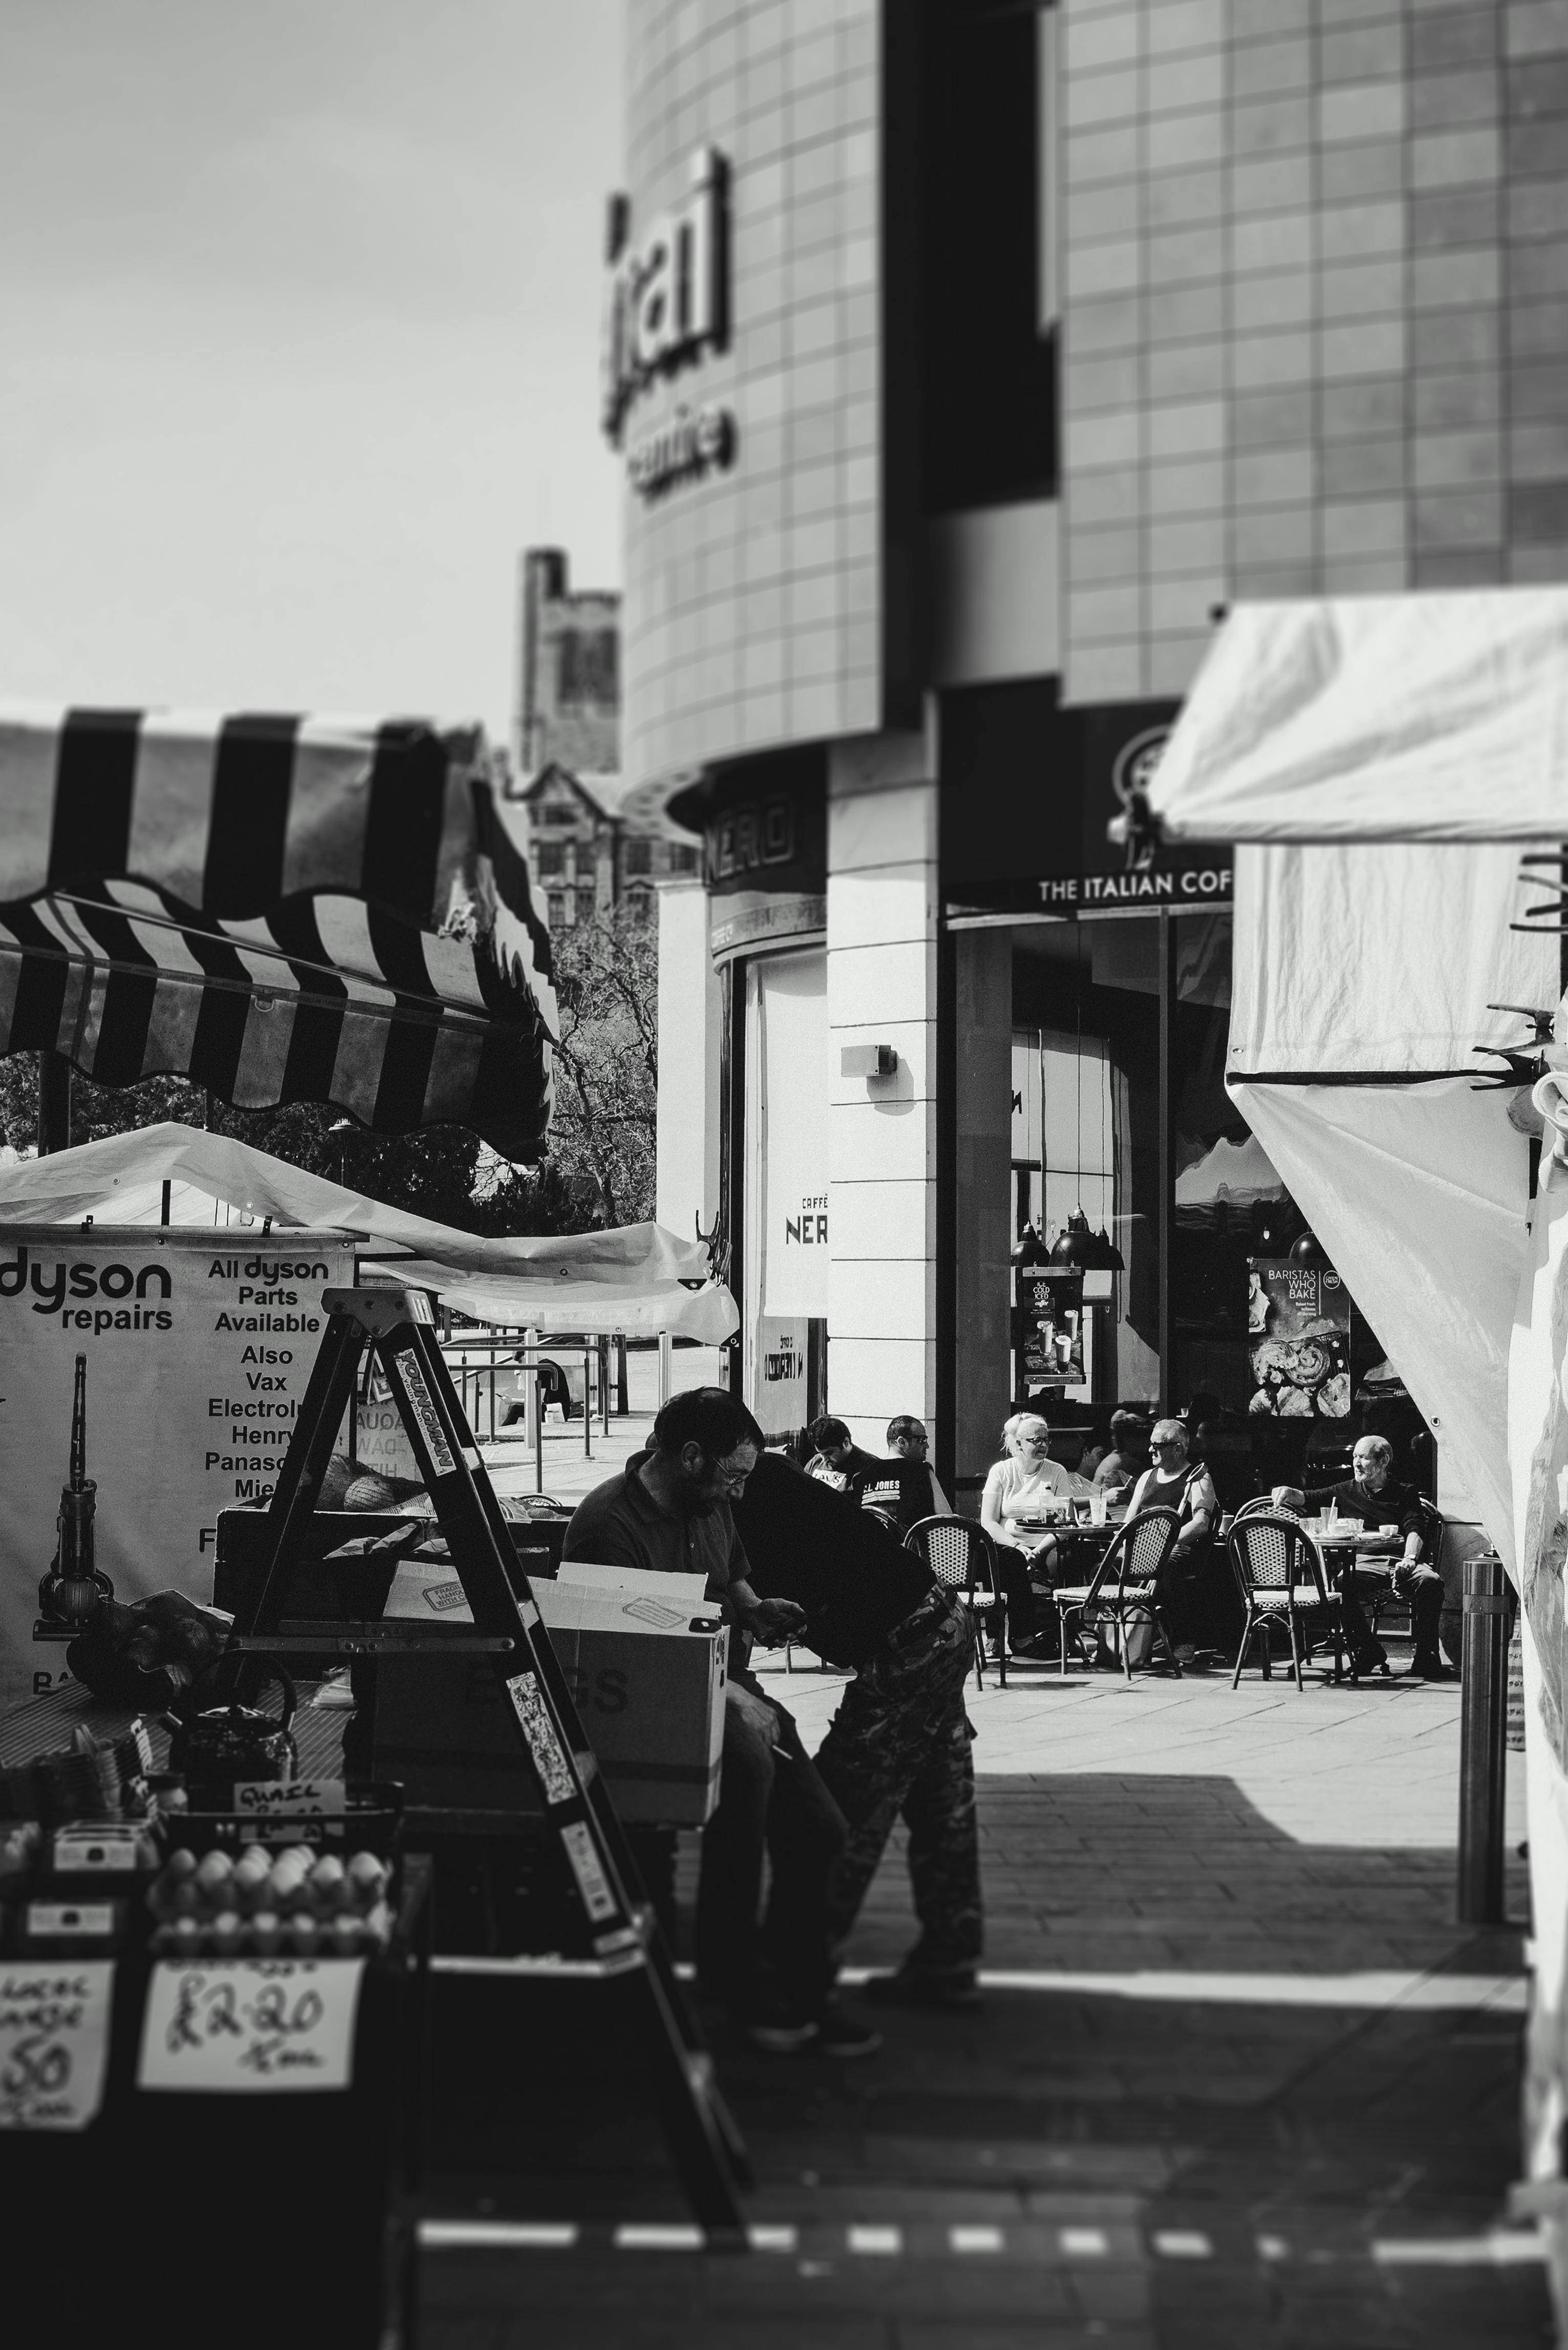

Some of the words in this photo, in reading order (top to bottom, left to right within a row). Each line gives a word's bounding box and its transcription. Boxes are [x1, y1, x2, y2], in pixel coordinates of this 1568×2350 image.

[1038, 879, 1078, 902] THE
[1083, 872, 1173, 900] ITALIAN
[786, 1215, 827, 1245] NER
[0, 1247, 172, 1314] dyson
[208, 1259, 238, 1278] All
[244, 1255, 329, 1287] dyson
[1268, 1270, 1316, 1280] BARISTAS
[1288, 1279, 1316, 1289] WHO
[239, 1286, 298, 1305] Parts
[1289, 1289, 1316, 1299] BAKE
[62, 1304, 173, 1336] repairs
[214, 1313, 321, 1333] Available
[241, 1346, 293, 1365] Also
[245, 1373, 288, 1391] Vax
[208, 1398, 302, 1418] Electrol
[401, 1351, 453, 1467] YOUNGMAN
[235, 1479, 279, 1498] Mie
[875, 1479, 900, 1491] JONES
[434, 1584, 463, 1596] FRAGIL
[436, 1596, 458, 1606] WITH
